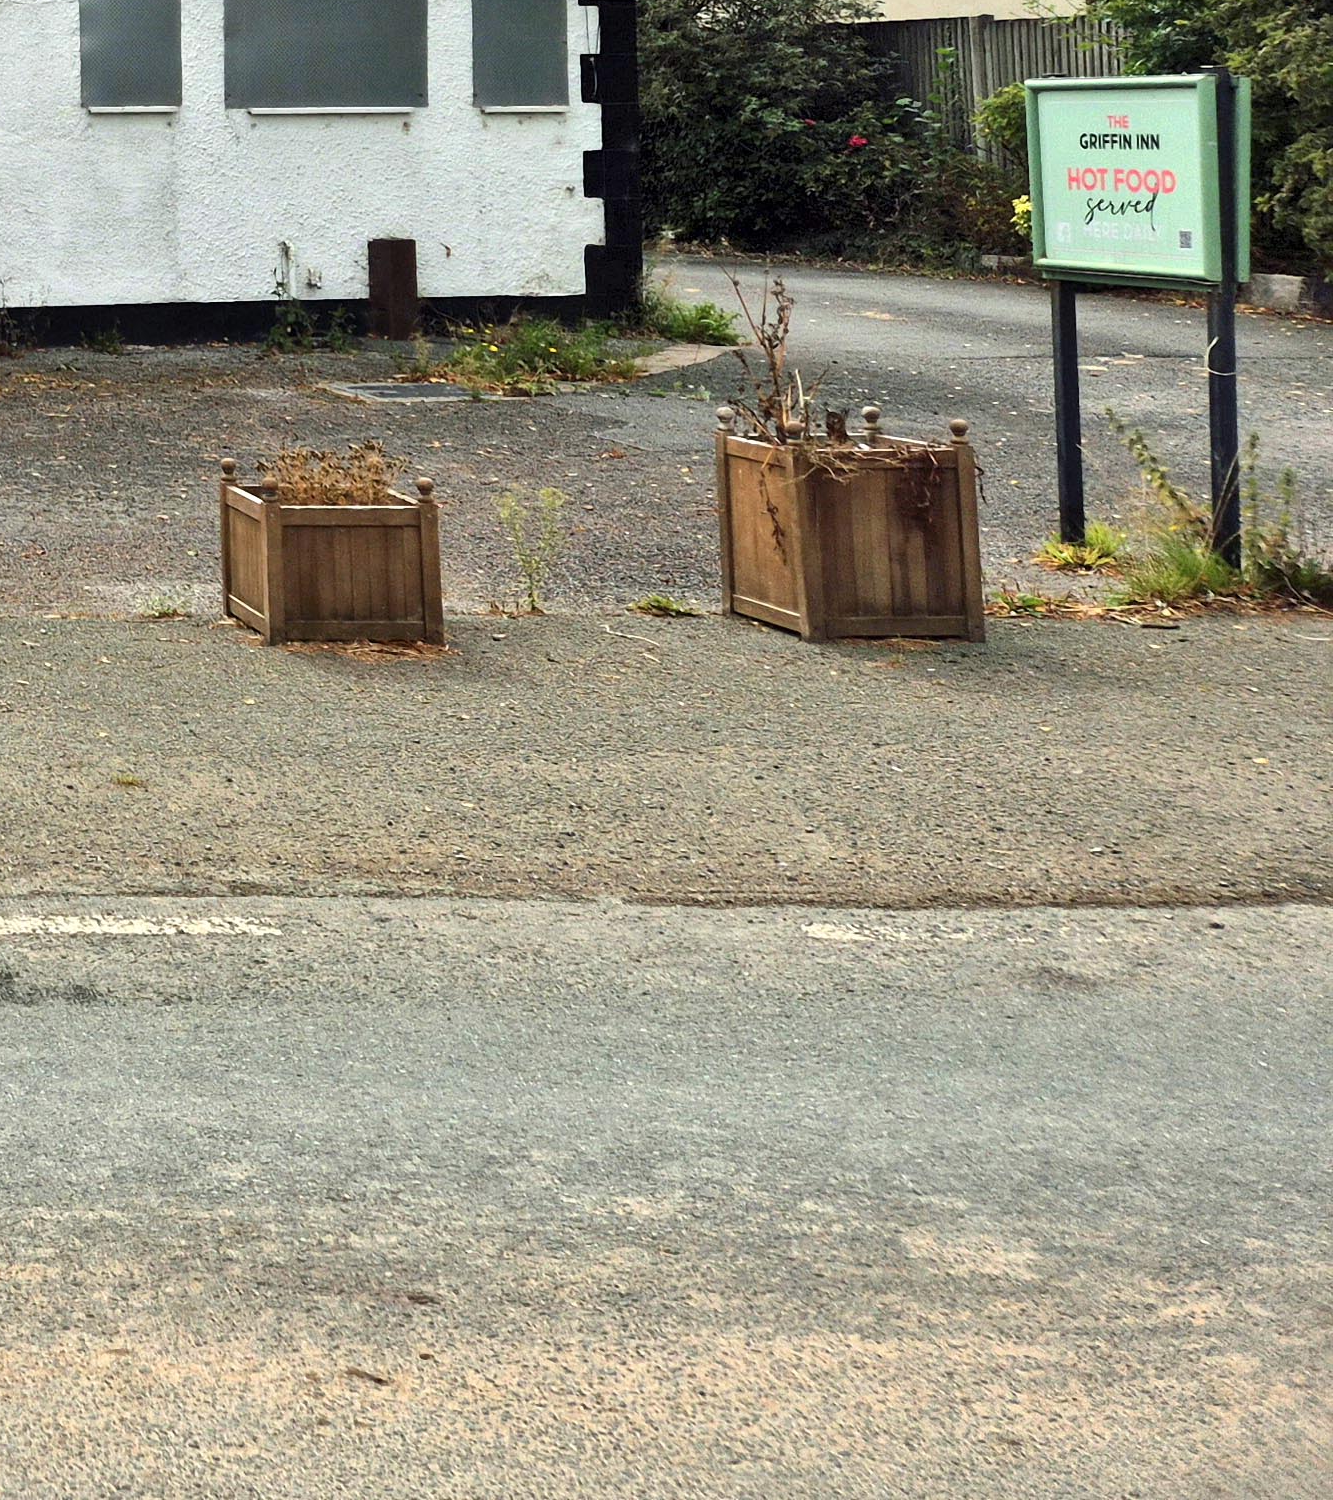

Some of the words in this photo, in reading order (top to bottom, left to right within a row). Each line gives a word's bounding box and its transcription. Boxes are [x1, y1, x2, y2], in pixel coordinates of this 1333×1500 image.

[1107, 115, 1129, 128] THE
[1079, 133, 1132, 150] GRIFFIN
[1136, 133, 1160, 150] INN
[1066, 167, 1108, 191] HOT
[1113, 168, 1177, 194] FOOD
[1085, 183, 1159, 231] served
